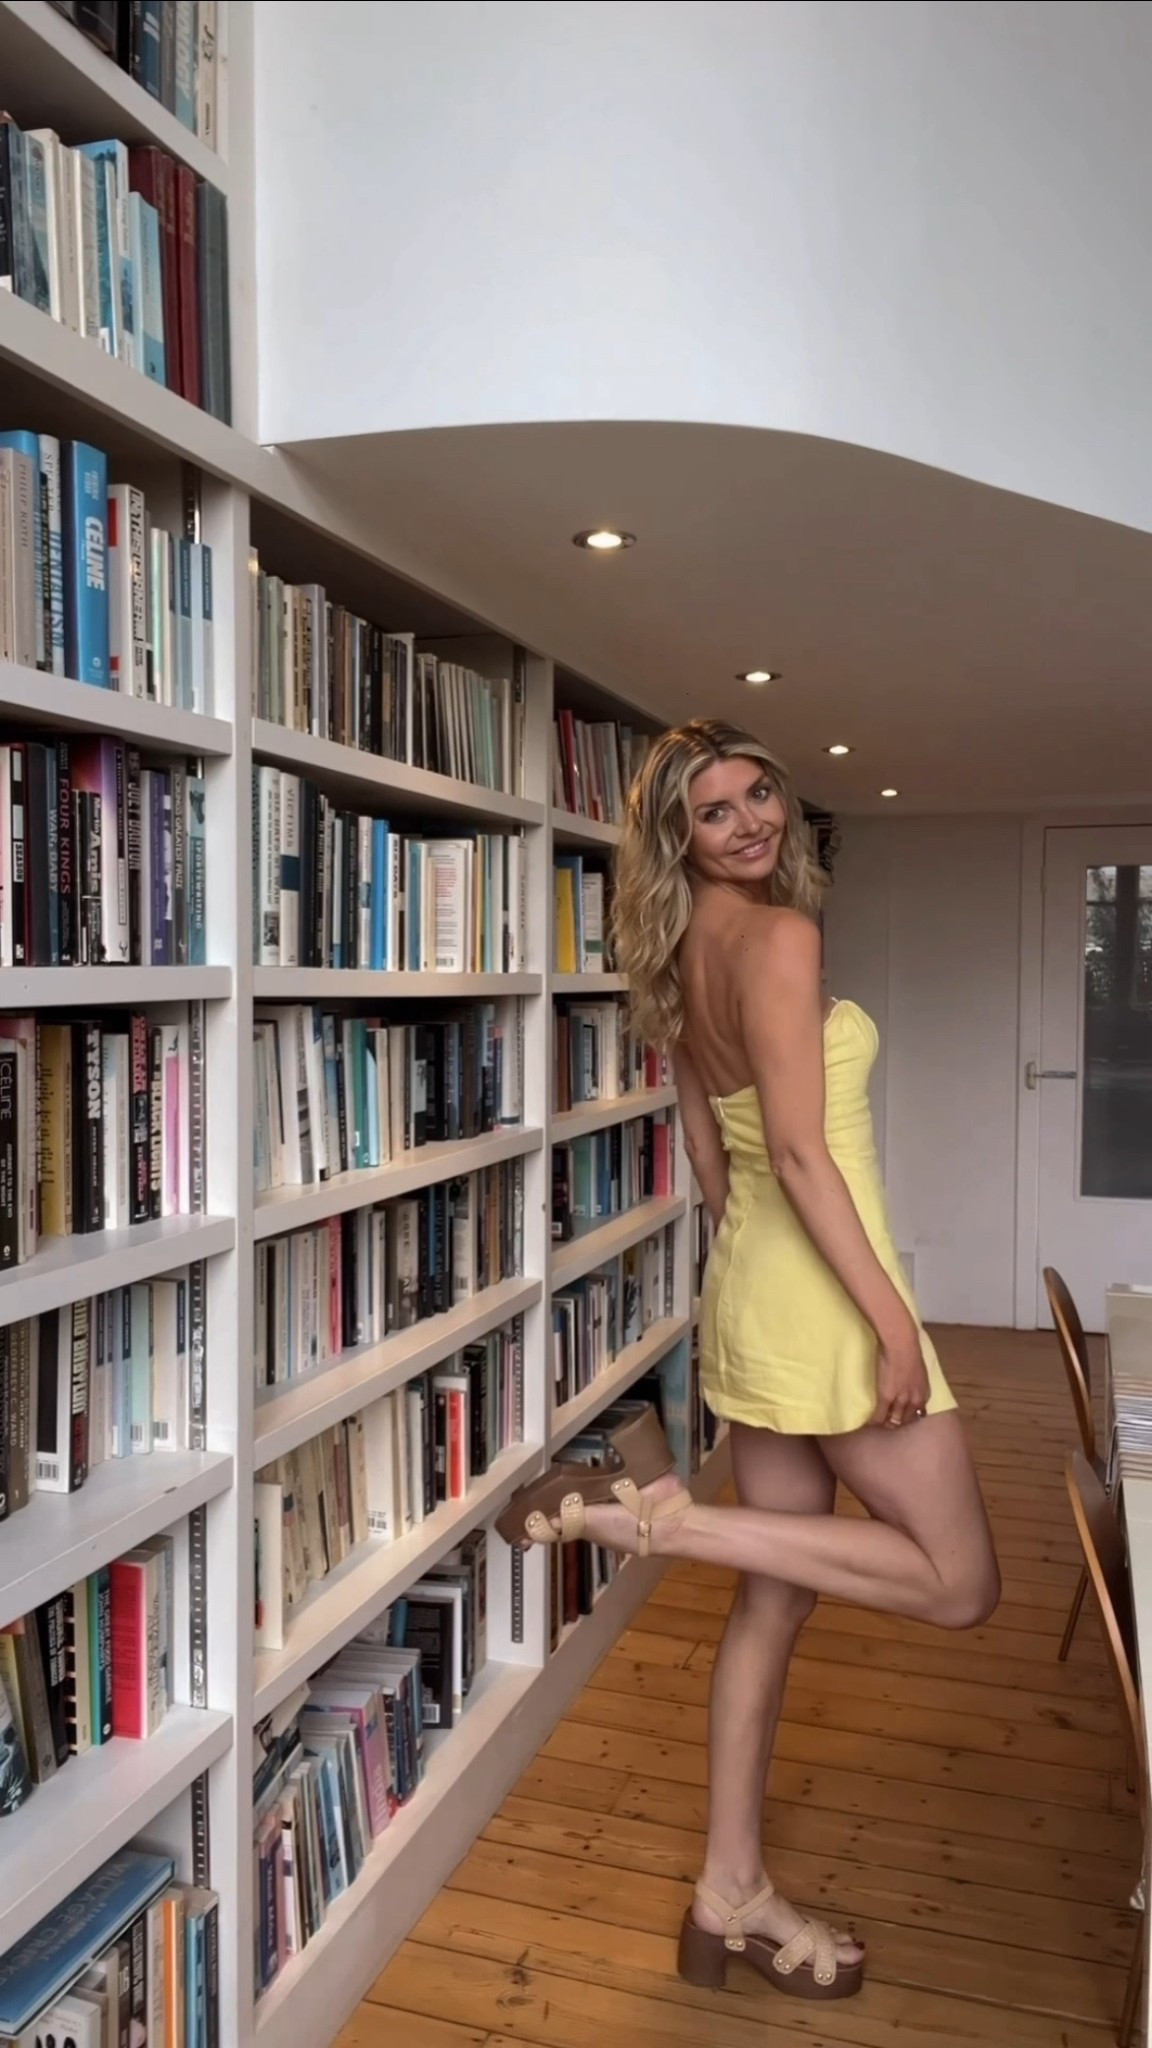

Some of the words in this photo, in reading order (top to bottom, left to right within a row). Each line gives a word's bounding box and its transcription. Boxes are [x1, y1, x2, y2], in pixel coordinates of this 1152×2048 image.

[59, 778, 70, 829] FOUR
[93, 797, 102, 833] Martin
[15, 843, 24, 881] SEASON
[60, 837, 71, 895] KINGS
[90, 831, 102, 894] Amis
[87, 1029, 101, 1119] TYSON
[10, 1333, 18, 1391] GEOFFREY
[10, 1412, 18, 1447] WARD
